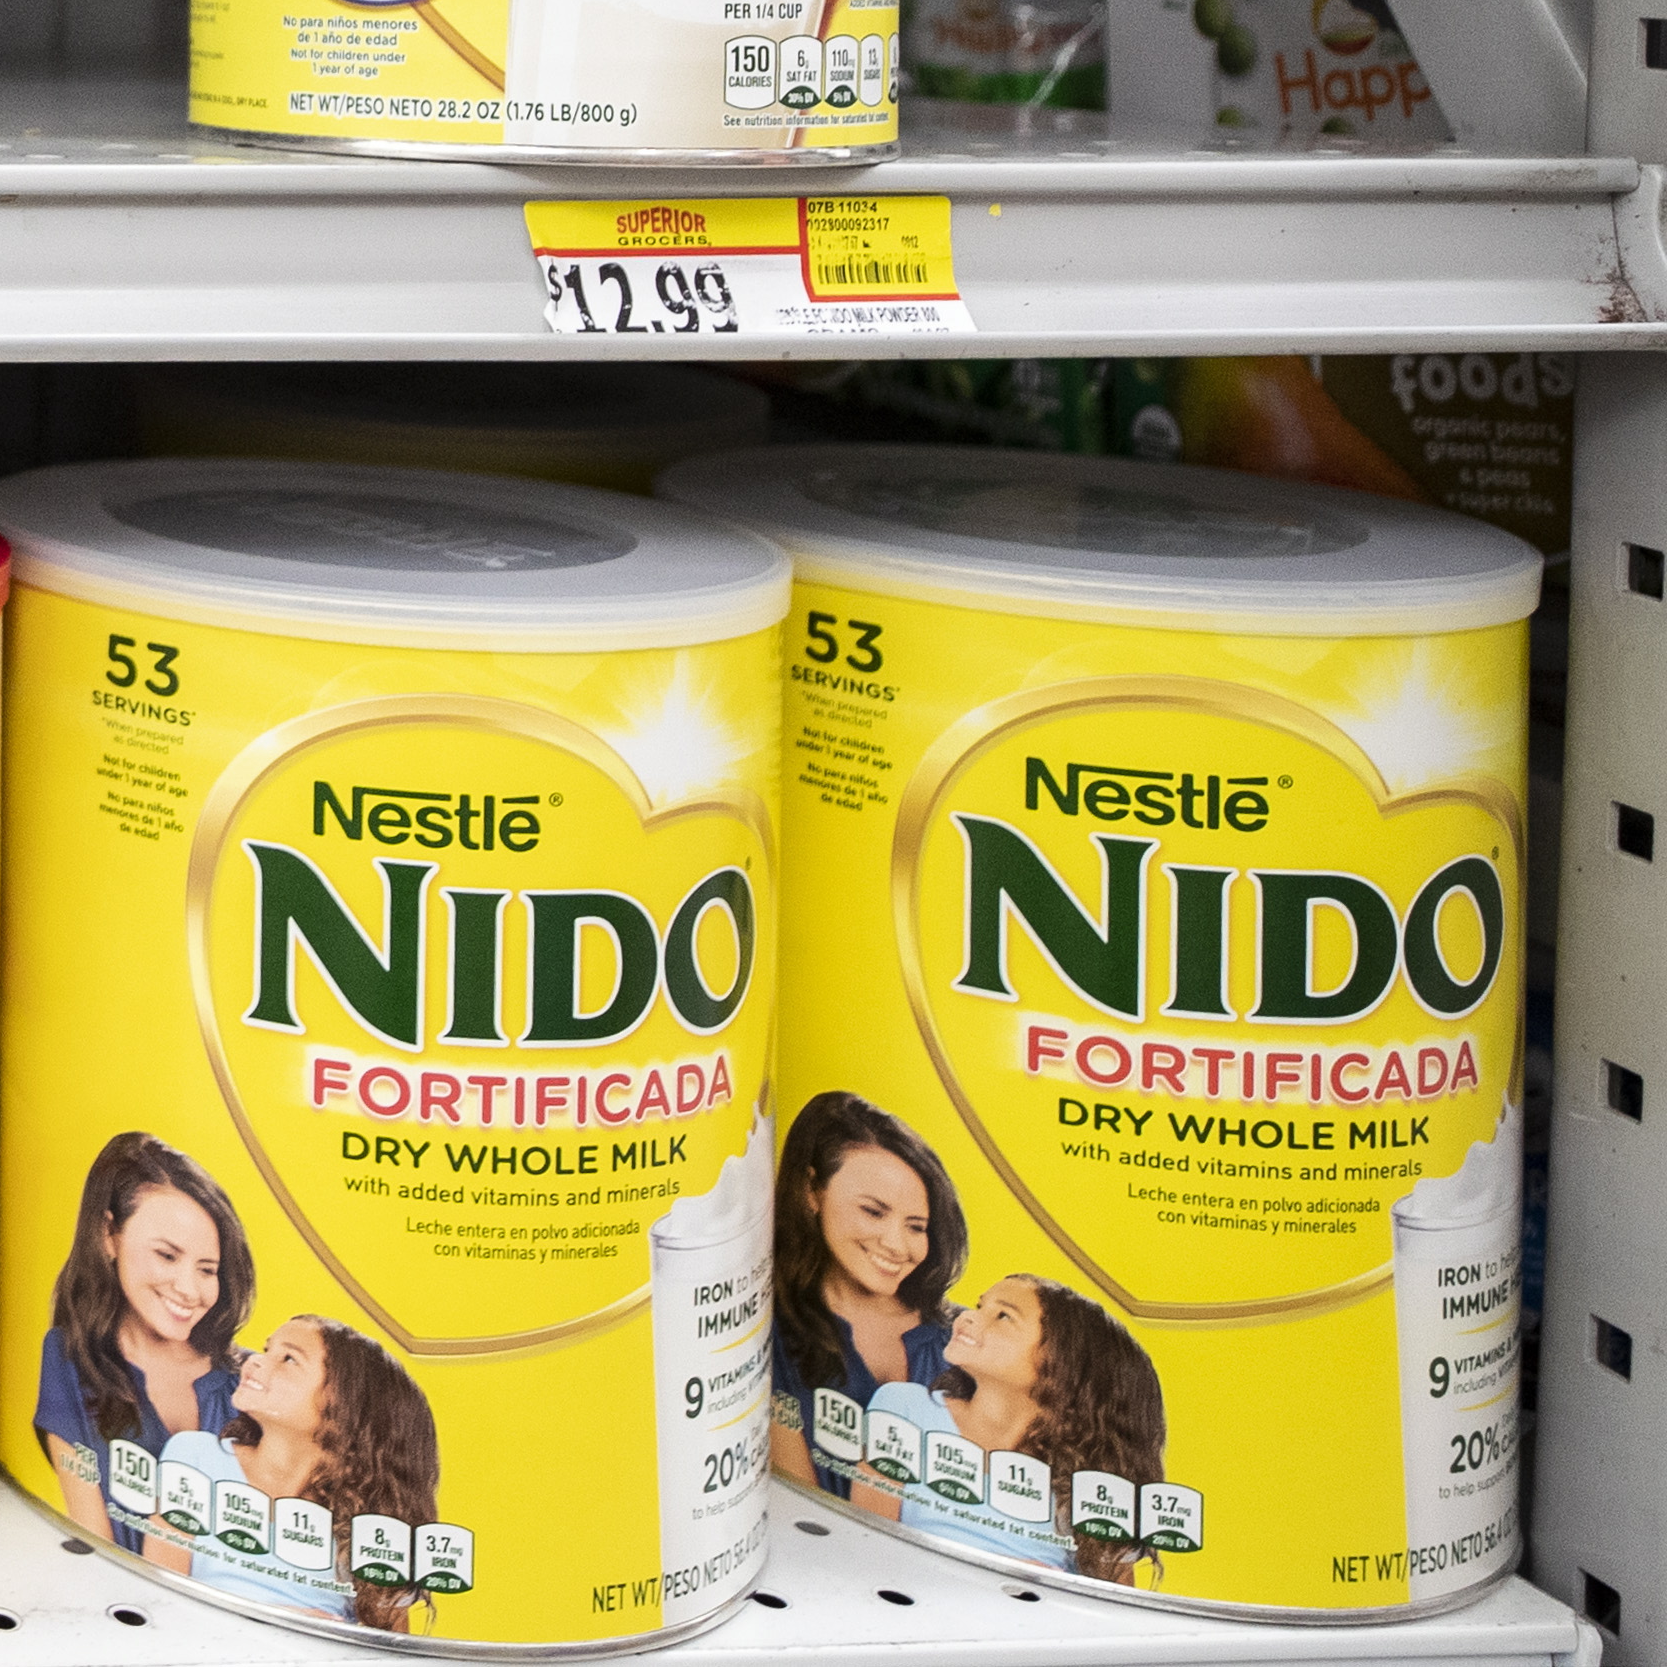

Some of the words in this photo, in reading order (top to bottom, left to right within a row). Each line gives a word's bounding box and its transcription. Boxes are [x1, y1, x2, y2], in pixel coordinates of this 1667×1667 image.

[289, 95, 317, 117] NET
[319, 95, 385, 120] WT/PESO
[389, 95, 432, 119] NETO
[438, 98, 470, 121] 28.2
[477, 98, 500, 121] OZ
[507, 100, 543, 124] (1.76
[550, 100, 615, 124] LB/800
[620, 101, 637, 126] g)
[1275, 49, 1431, 121] Happ
[616, 209, 706, 233] SUPERIOR
[546, 258, 740, 332] $12.99
[1390, 354, 1572, 411] foods
[105, 634, 181, 698] 53
[805, 610, 883, 673] 53
[313, 781, 539, 852] Nestlé
[1025, 756, 1268, 832] Nestlé
[242, 839, 755, 1052] NIDO
[951, 812, 1503, 1023] NIDO
[313, 1056, 733, 1128] FORTIFICADA
[1027, 1025, 1478, 1103] FORTIFICADA
[342, 1133, 429, 1168] DRY
[445, 1145, 597, 1176] WHOLE
[612, 1135, 687, 1169] MILK
[1058, 1098, 1152, 1137] DRY
[1168, 1113, 1335, 1150] WHOLE
[1349, 1116, 1429, 1146] MILK
[345, 1175, 392, 1199] with
[397, 1183, 465, 1205] added
[471, 1186, 561, 1206] vitamins
[566, 1184, 601, 1205] and
[606, 1179, 681, 1203] minerals
